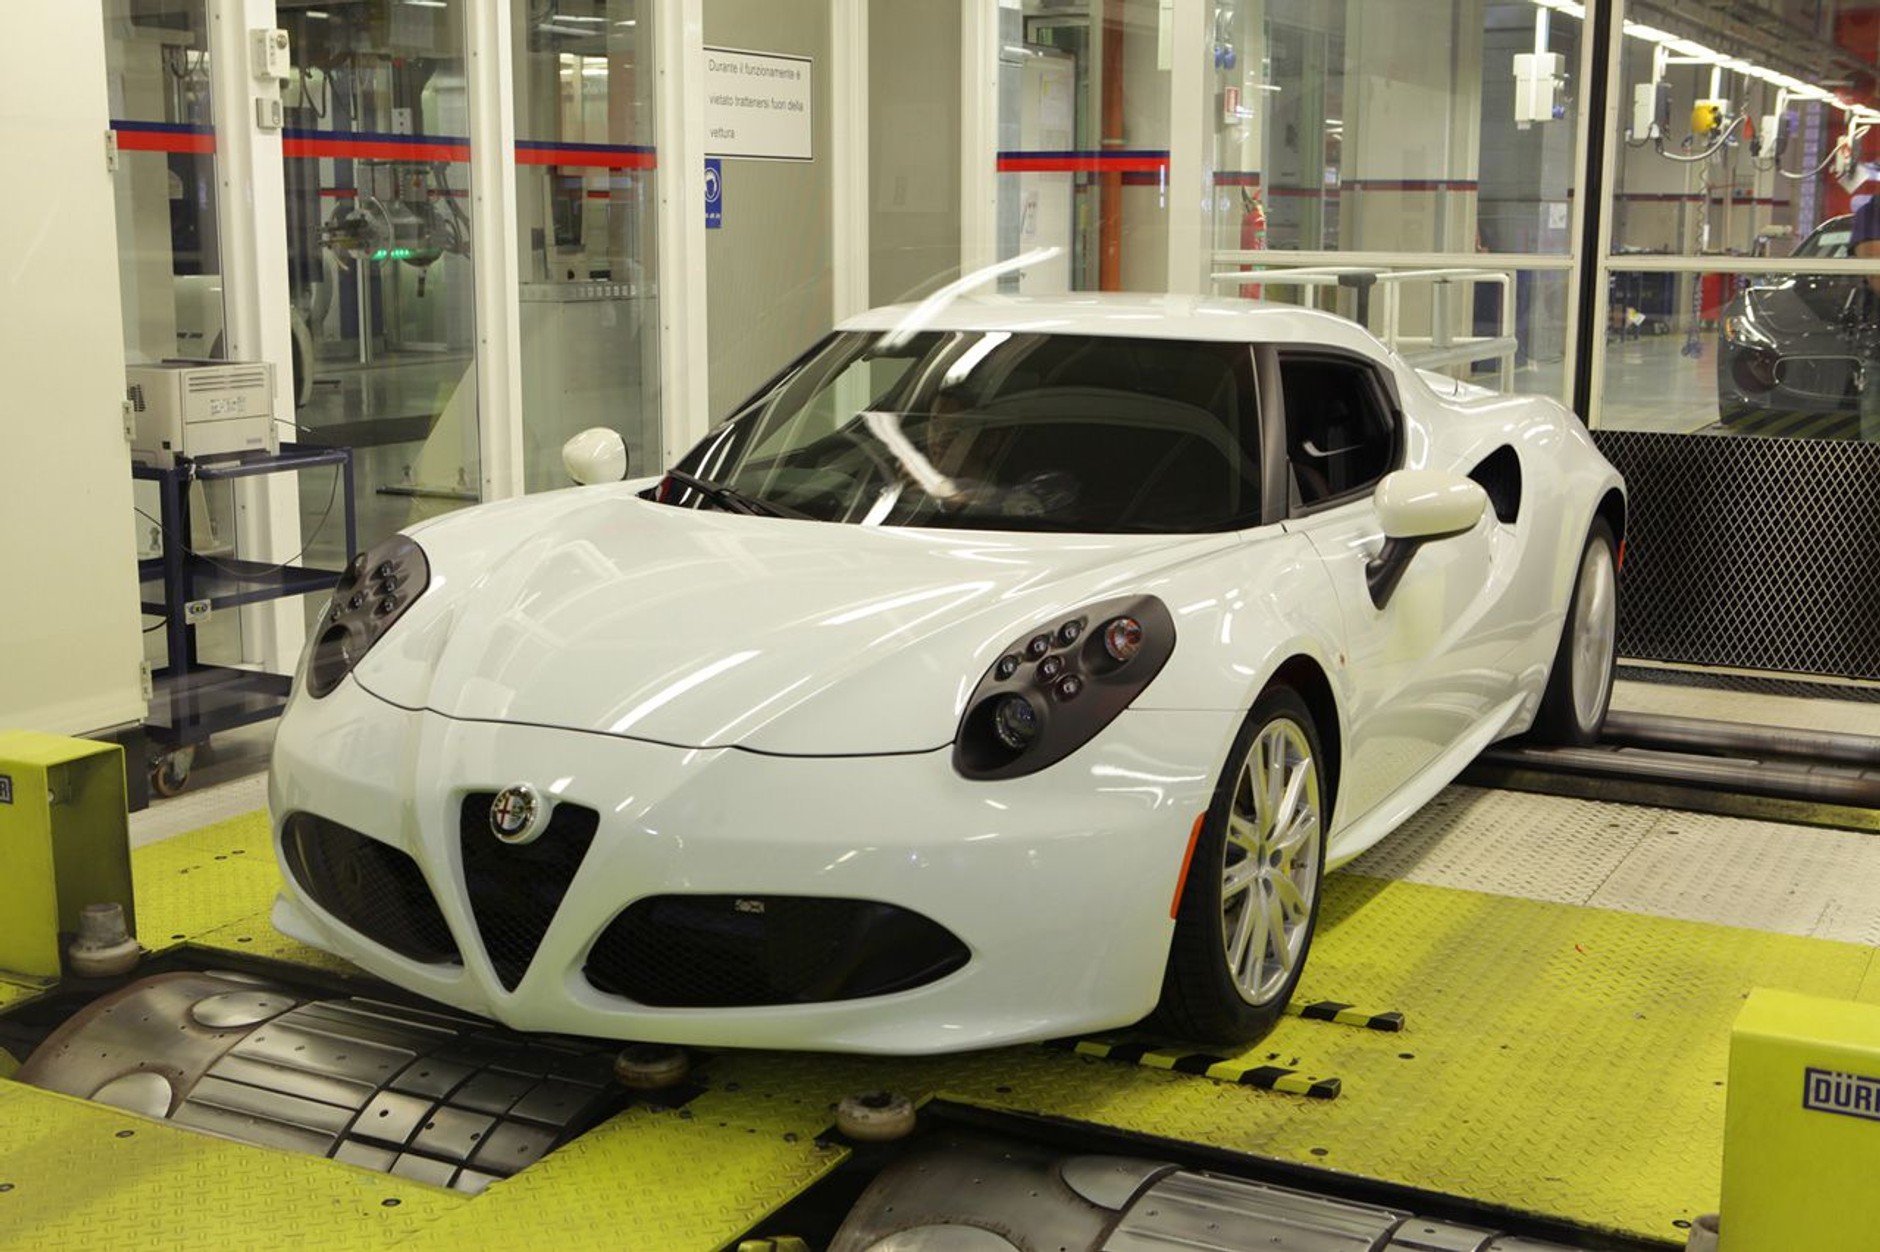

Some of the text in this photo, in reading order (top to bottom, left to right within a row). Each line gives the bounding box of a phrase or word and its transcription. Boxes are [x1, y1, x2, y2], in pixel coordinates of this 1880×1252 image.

[708, 58, 738, 74] Durante
[739, 62, 744, 74] il
[709, 94, 804, 112] vietato trattenersi fuori della
[710, 128, 735, 139] vettura
